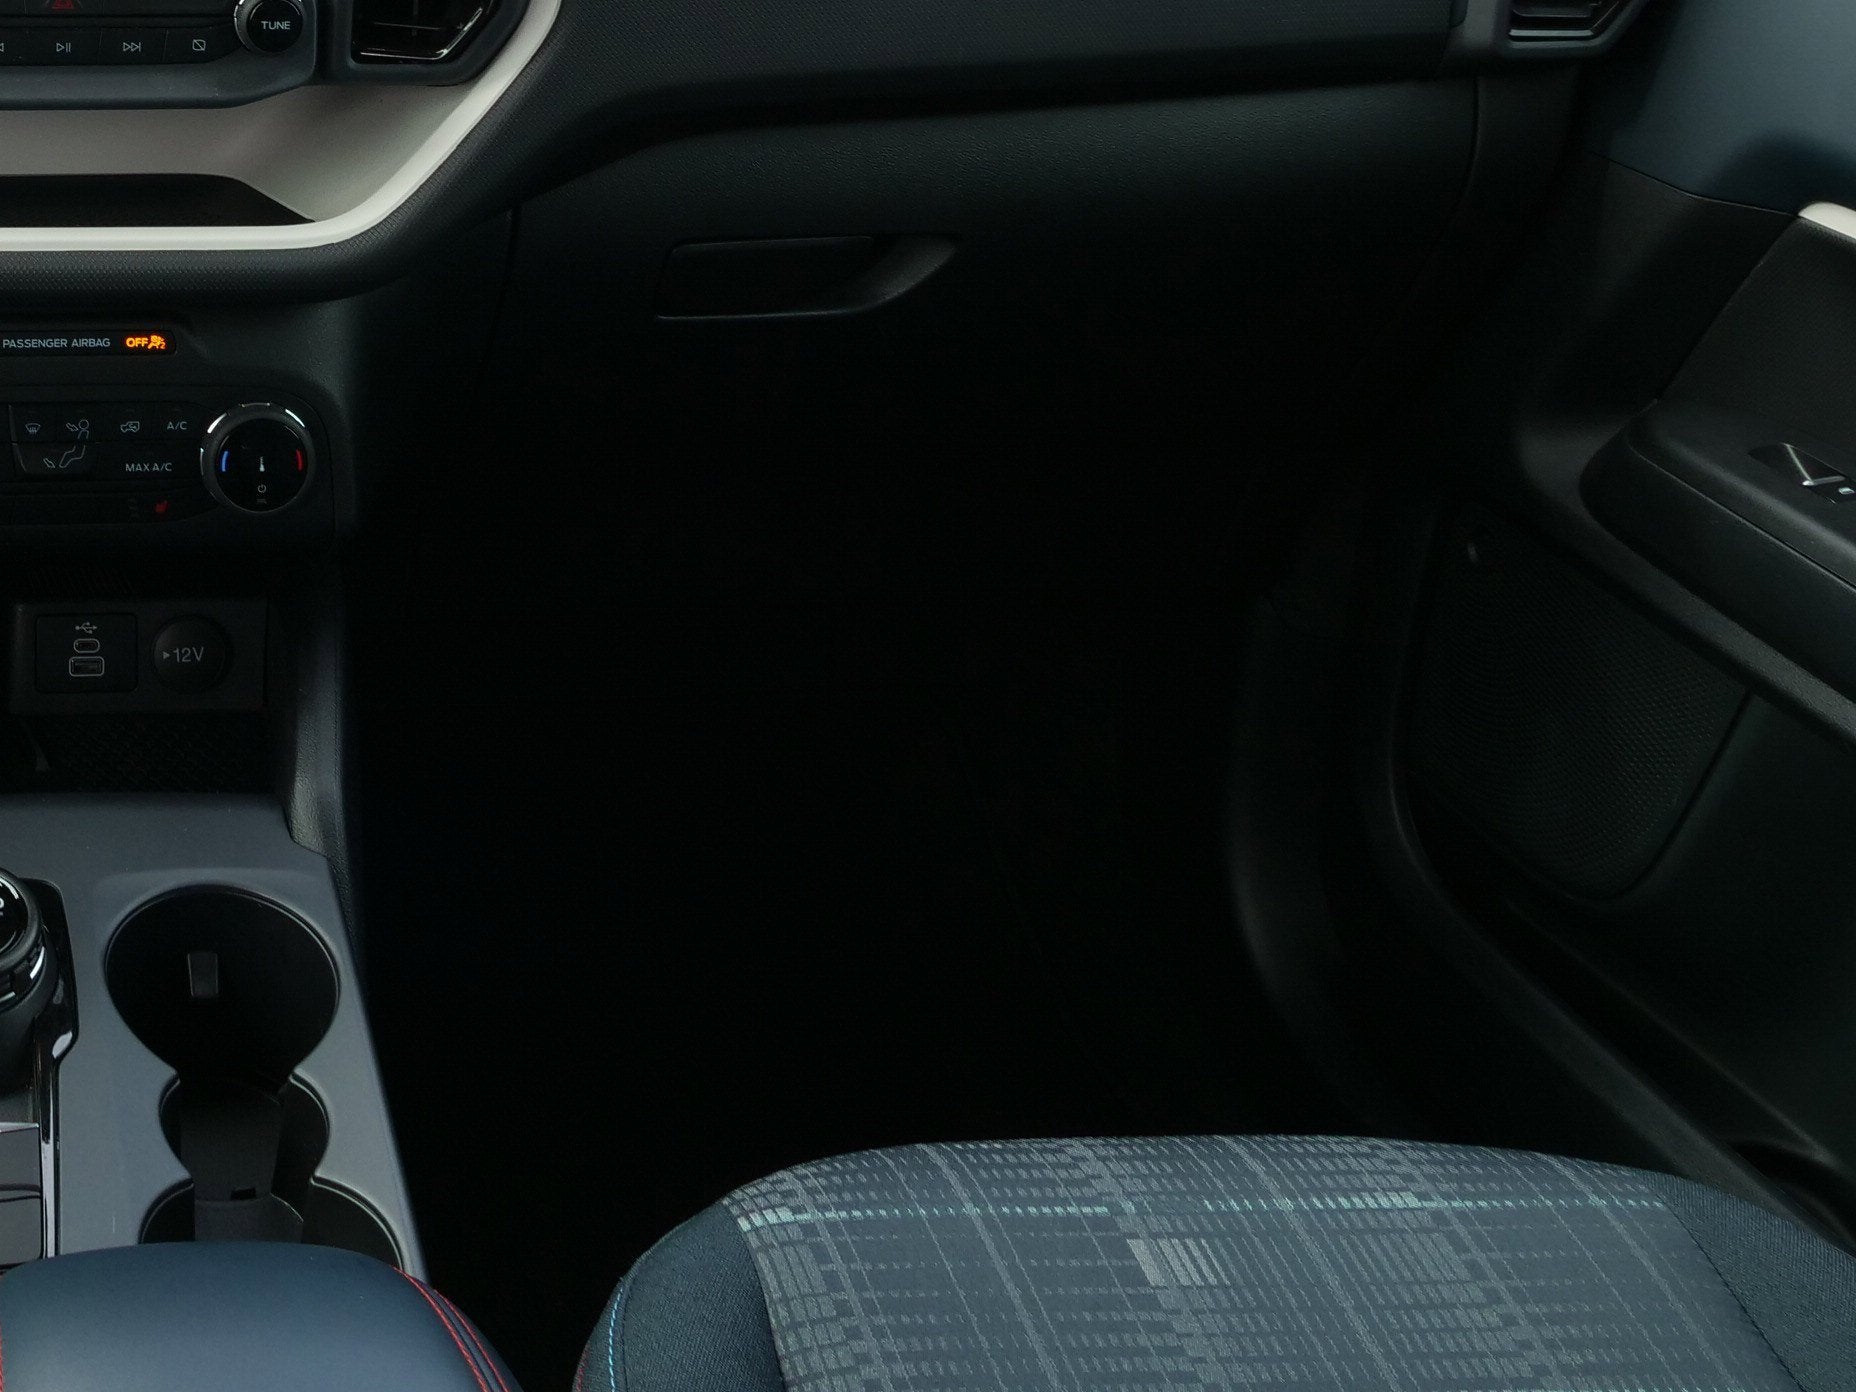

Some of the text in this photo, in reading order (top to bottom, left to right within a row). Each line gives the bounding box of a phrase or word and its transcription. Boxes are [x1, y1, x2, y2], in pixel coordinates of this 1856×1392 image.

[261, 20, 291, 30] TUNE
[2, 337, 148, 348] PASSENGER AIRBAG OFF
[166, 421, 188, 431] A/C
[125, 462, 173, 472] MAX A/C
[173, 646, 205, 662] 12V
